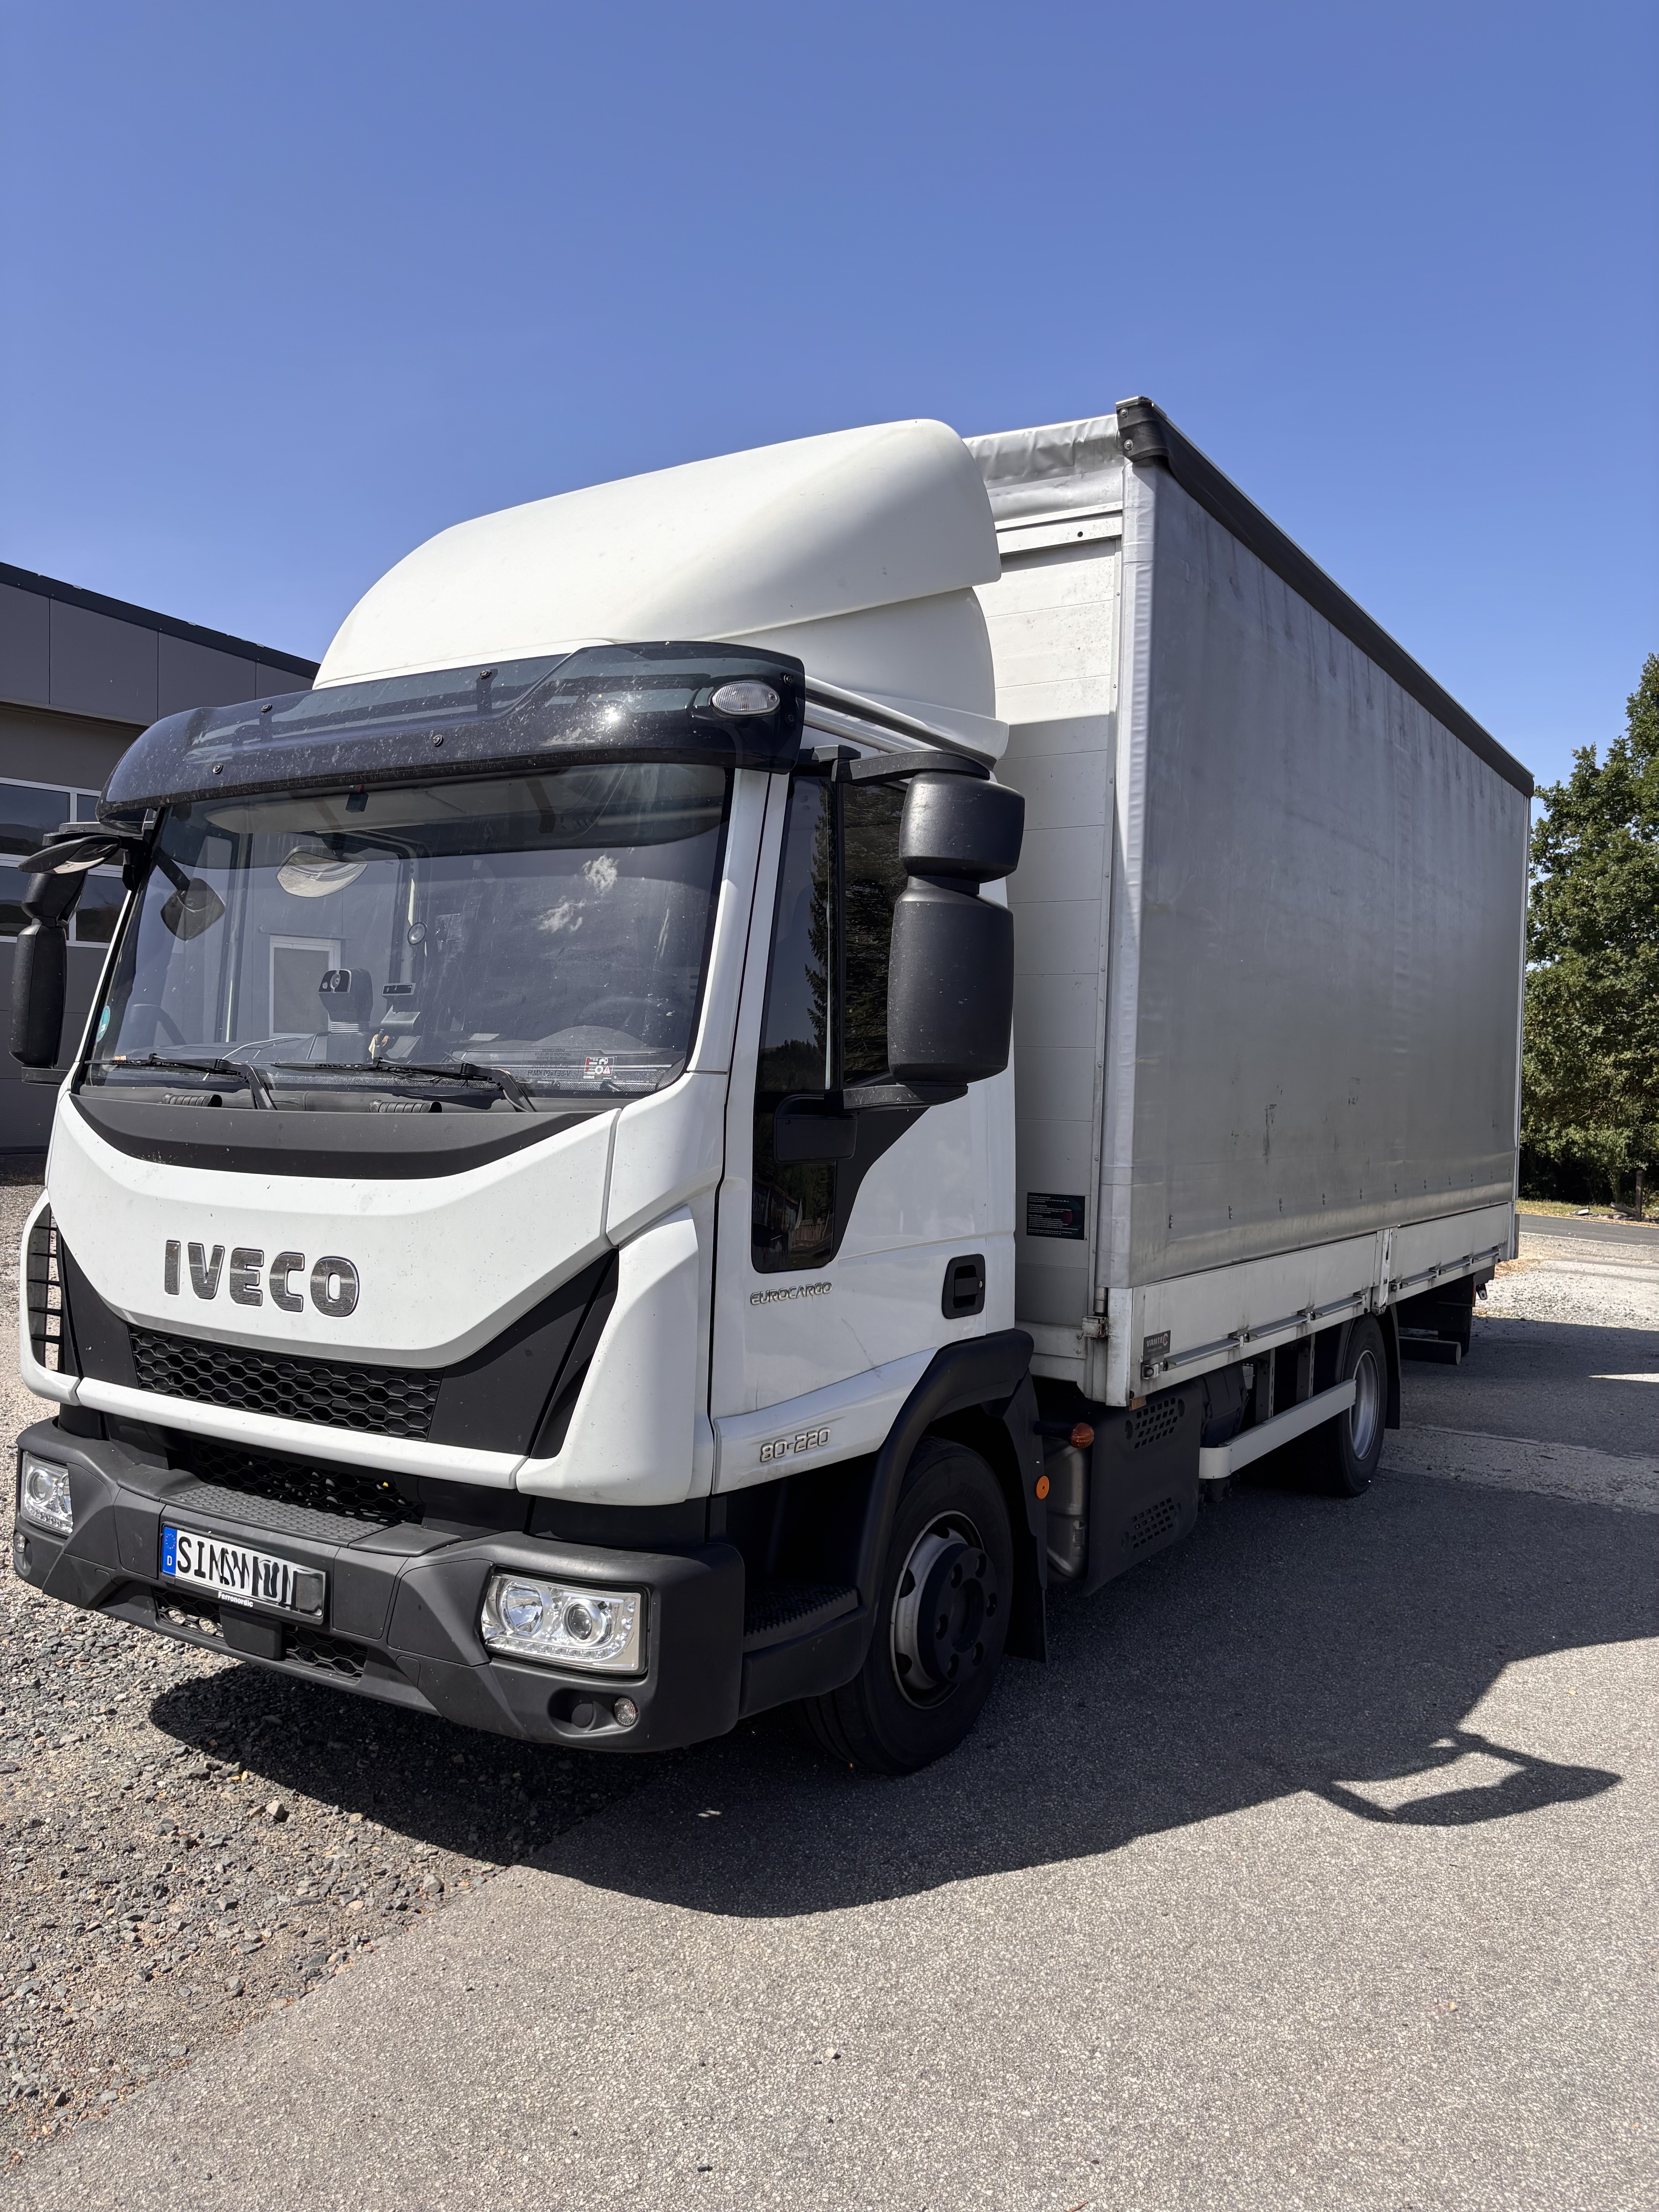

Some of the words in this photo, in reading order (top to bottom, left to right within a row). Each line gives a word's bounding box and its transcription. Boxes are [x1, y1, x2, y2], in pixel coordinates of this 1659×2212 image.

[164, 1239, 360, 1317] IVECO
[750, 1281, 832, 1305] EUROCARGO
[1146, 1333, 1168, 1347] VANTEC
[760, 1427, 830, 1463] 80-220
[167, 1555, 172, 1566] D
[218, 1591, 253, 1607] Ferronordic
